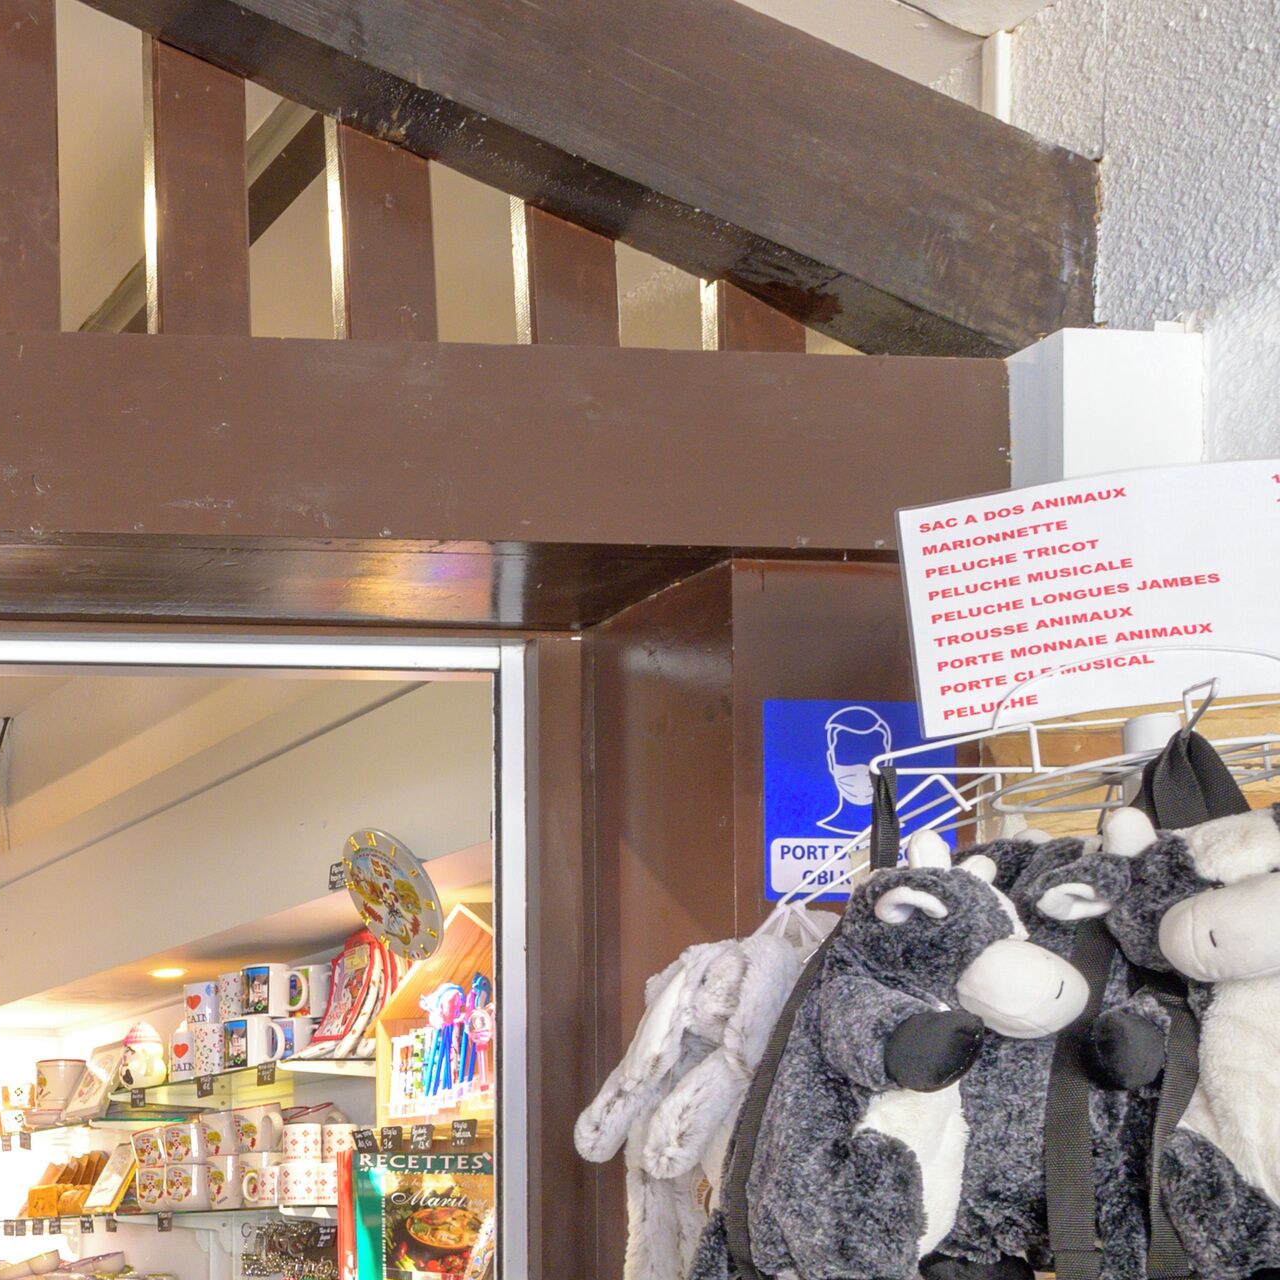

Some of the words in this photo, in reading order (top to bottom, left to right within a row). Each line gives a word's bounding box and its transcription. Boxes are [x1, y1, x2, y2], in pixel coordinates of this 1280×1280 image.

[919, 516, 958, 533] SAC
[964, 513, 978, 526] A
[983, 504, 1025, 521] DOS
[1031, 487, 1127, 511] ANIMAUX
[922, 520, 1068, 556] MARIONNETTE
[925, 553, 1018, 579] PELUCHE
[1023, 539, 1099, 561] TRICOT
[928, 575, 1020, 601] PELUCHE
[1027, 558, 1133, 584] MUSICALE
[931, 599, 1024, 624] PELUCHE
[1030, 583, 1130, 607] LONGUES
[1136, 573, 1221, 591] JAMBES
[933, 622, 1029, 648] TROUSSE
[1035, 606, 1133, 630] ANIMAUX
[937, 650, 1004, 672] PORTE
[1010, 634, 1108, 659] MONNAIE
[1114, 622, 1213, 643] ANIMAUX
[940, 675, 1007, 696] PORTE
[360, 1154, 483, 1169] RECETTES
